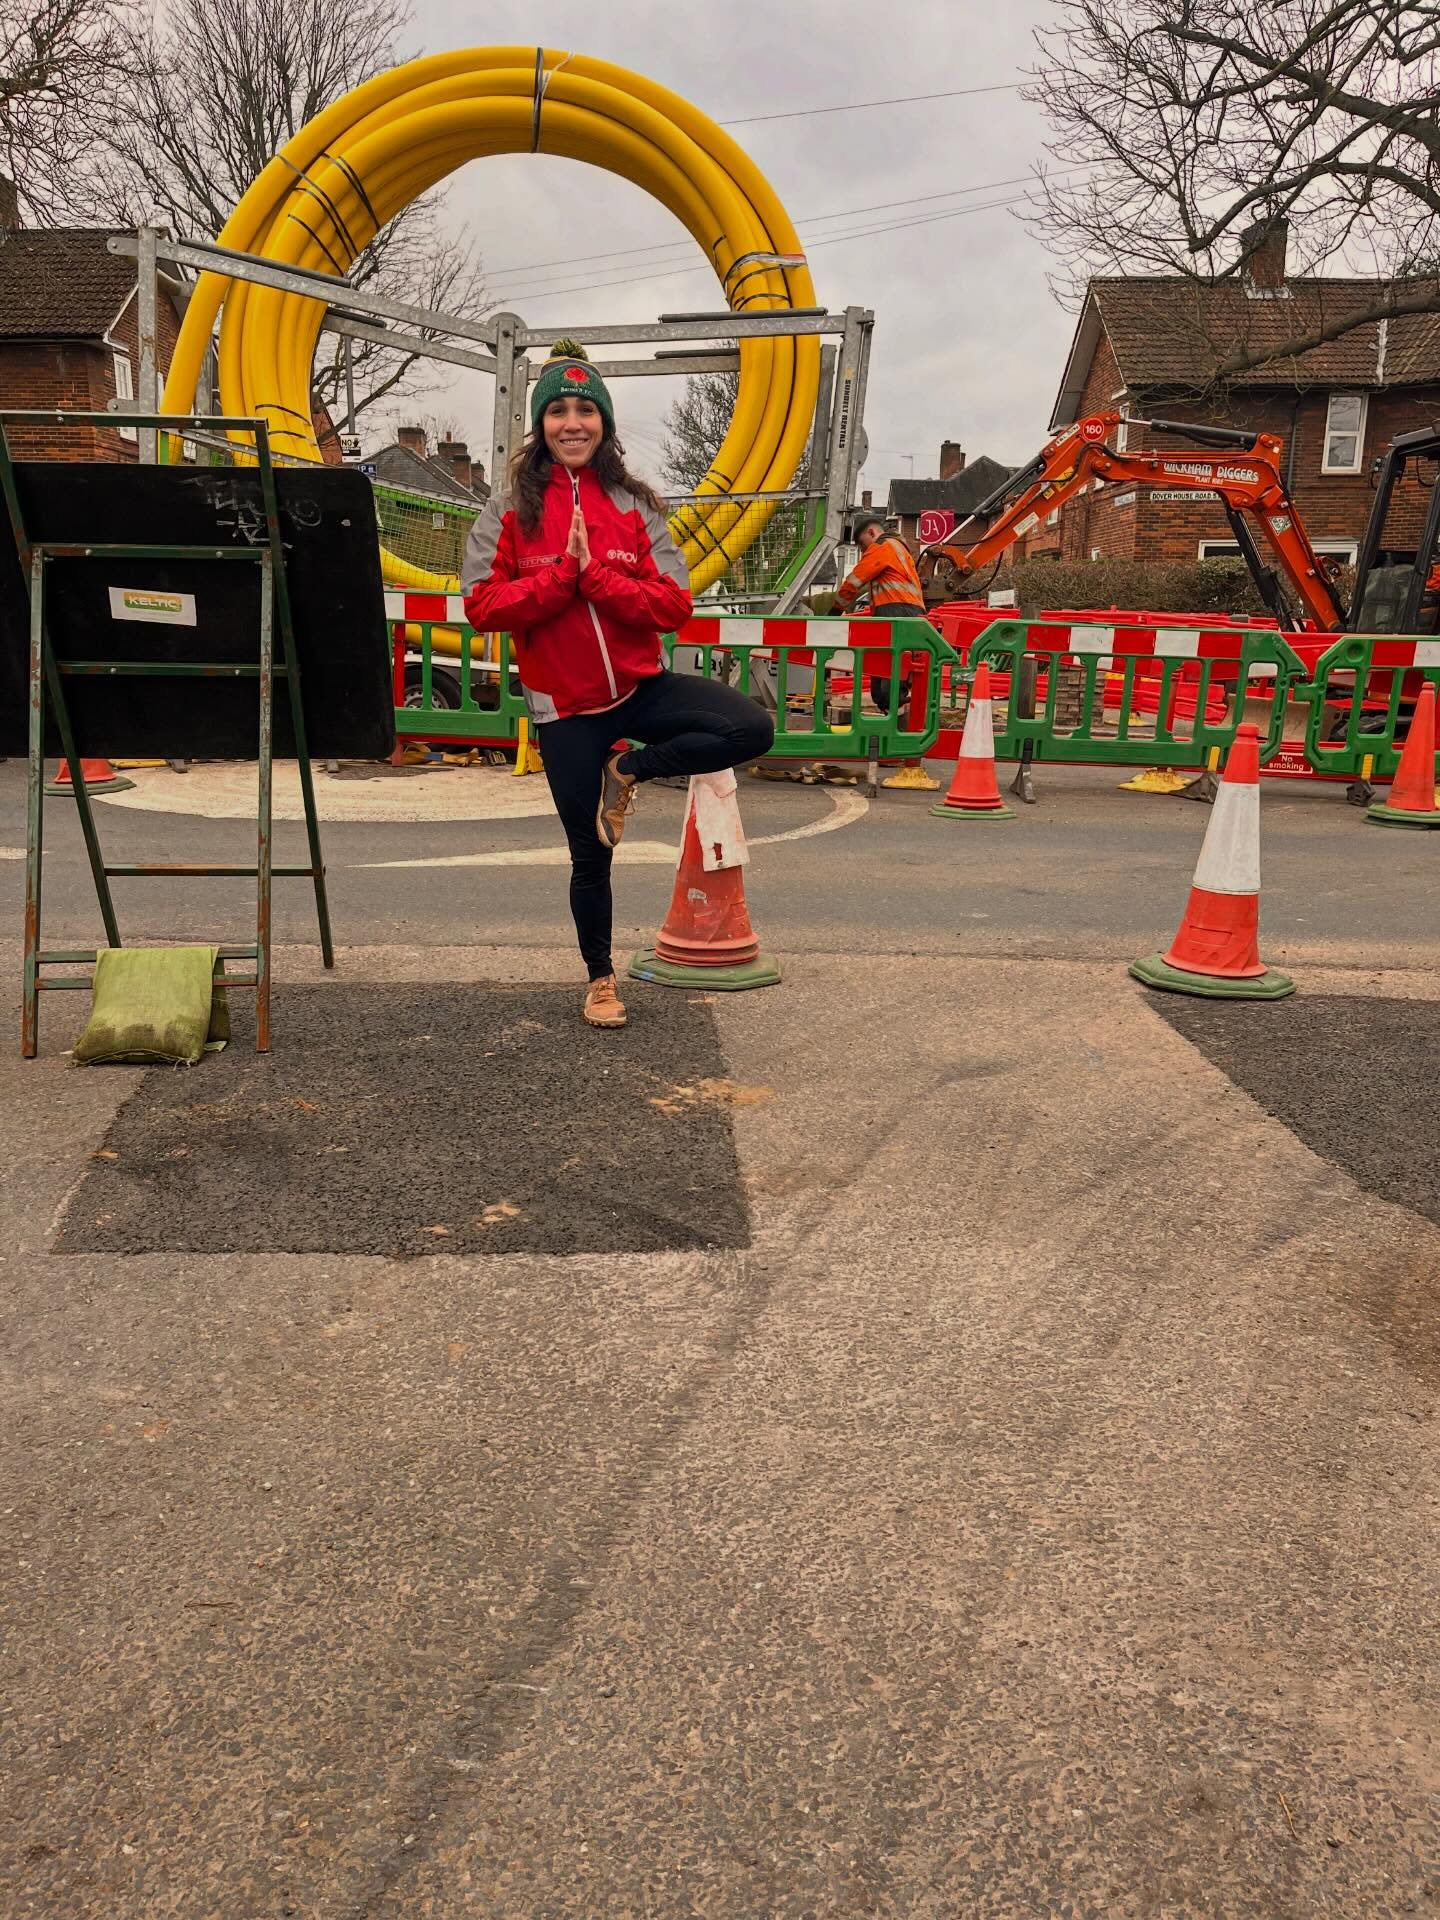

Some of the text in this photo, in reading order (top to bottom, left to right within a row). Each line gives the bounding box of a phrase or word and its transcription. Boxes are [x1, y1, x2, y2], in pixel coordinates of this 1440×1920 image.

[839, 415, 848, 448] RENTALS
[1085, 424, 1103, 435] 160
[1163, 462, 1259, 482] WICKHAM DIGGERS
[1152, 492, 1172, 500] DOVER
[1173, 492, 1194, 500] HOUSE
[1195, 492, 1212, 500] ROAD
[128, 595, 178, 609] KELTIC
[1281, 755, 1293, 763] No
[1269, 762, 1304, 771] smoking
